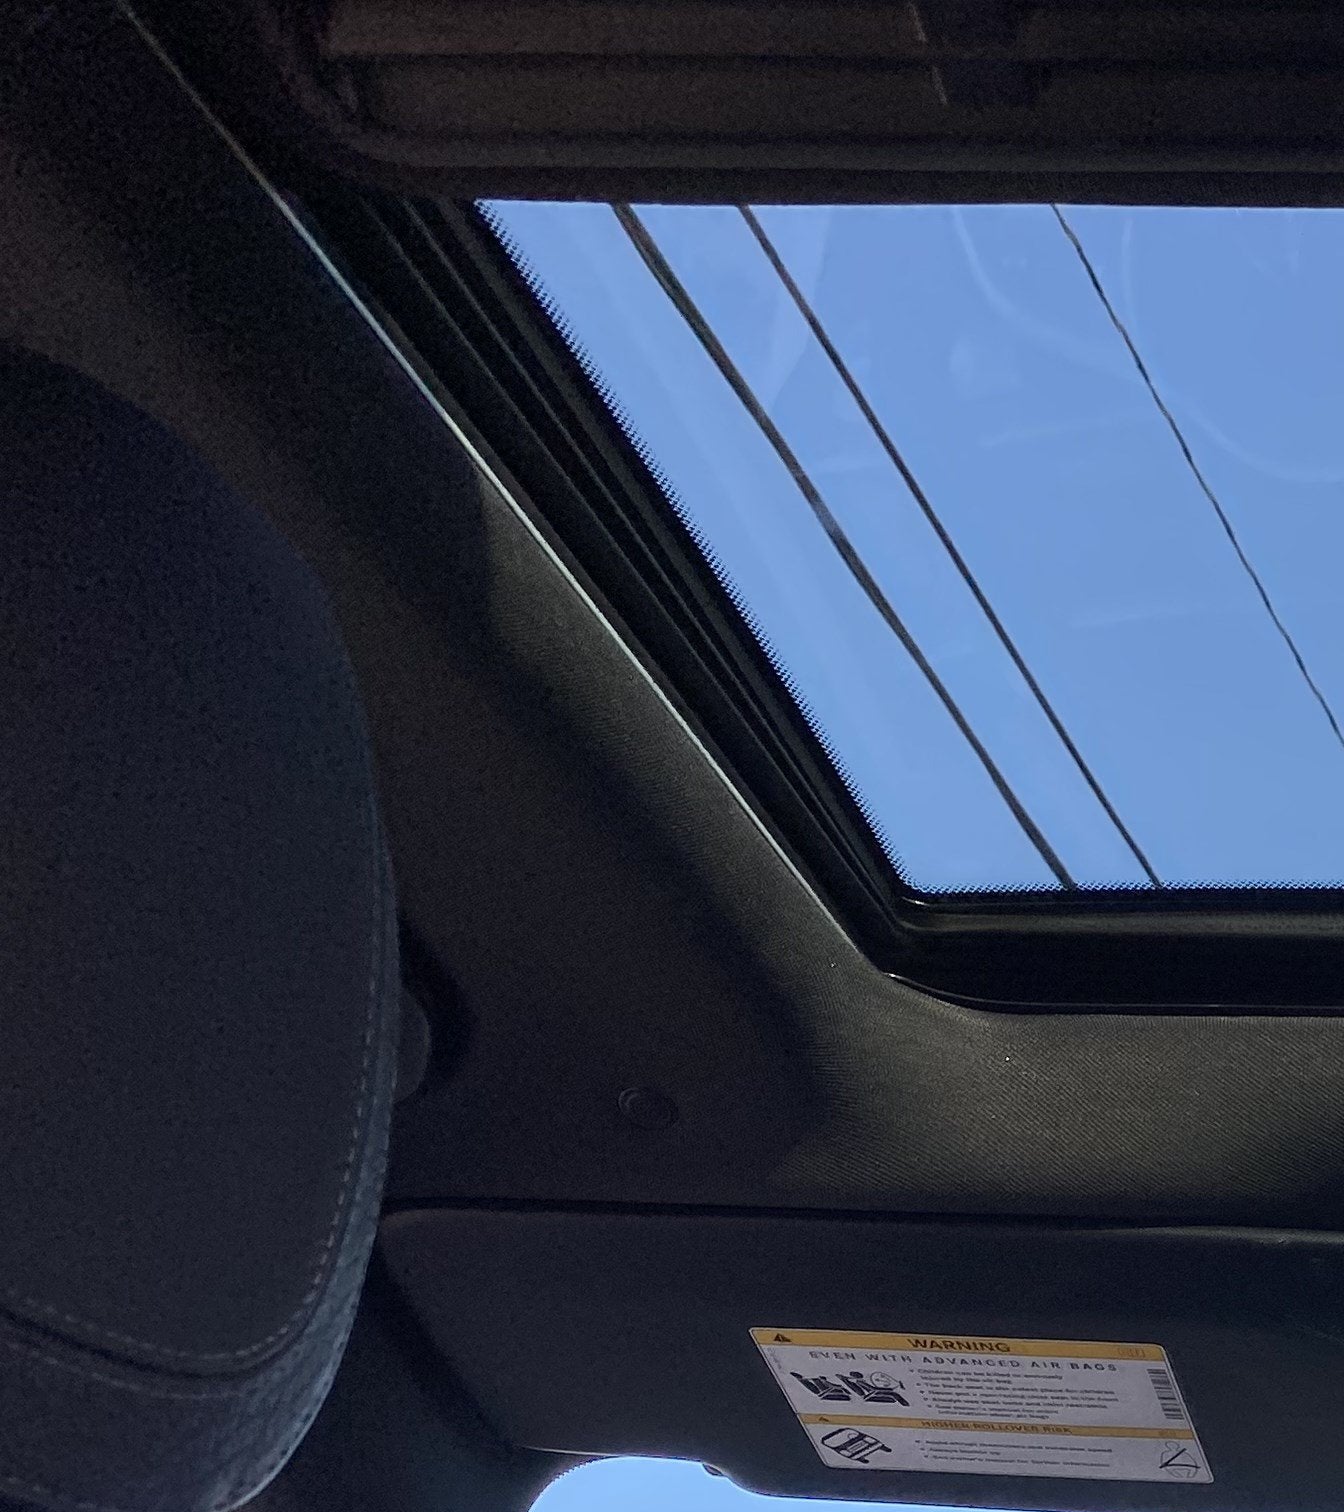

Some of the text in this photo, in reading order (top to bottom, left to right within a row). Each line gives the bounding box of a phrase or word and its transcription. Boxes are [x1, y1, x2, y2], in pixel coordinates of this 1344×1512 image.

[908, 1338, 1011, 1353] WARNING
[809, 1350, 1118, 1372] EVEN WITH ADVANCED AIR BAGS
[921, 1420, 1073, 1434] HIGHER ROLLOVER RISK
